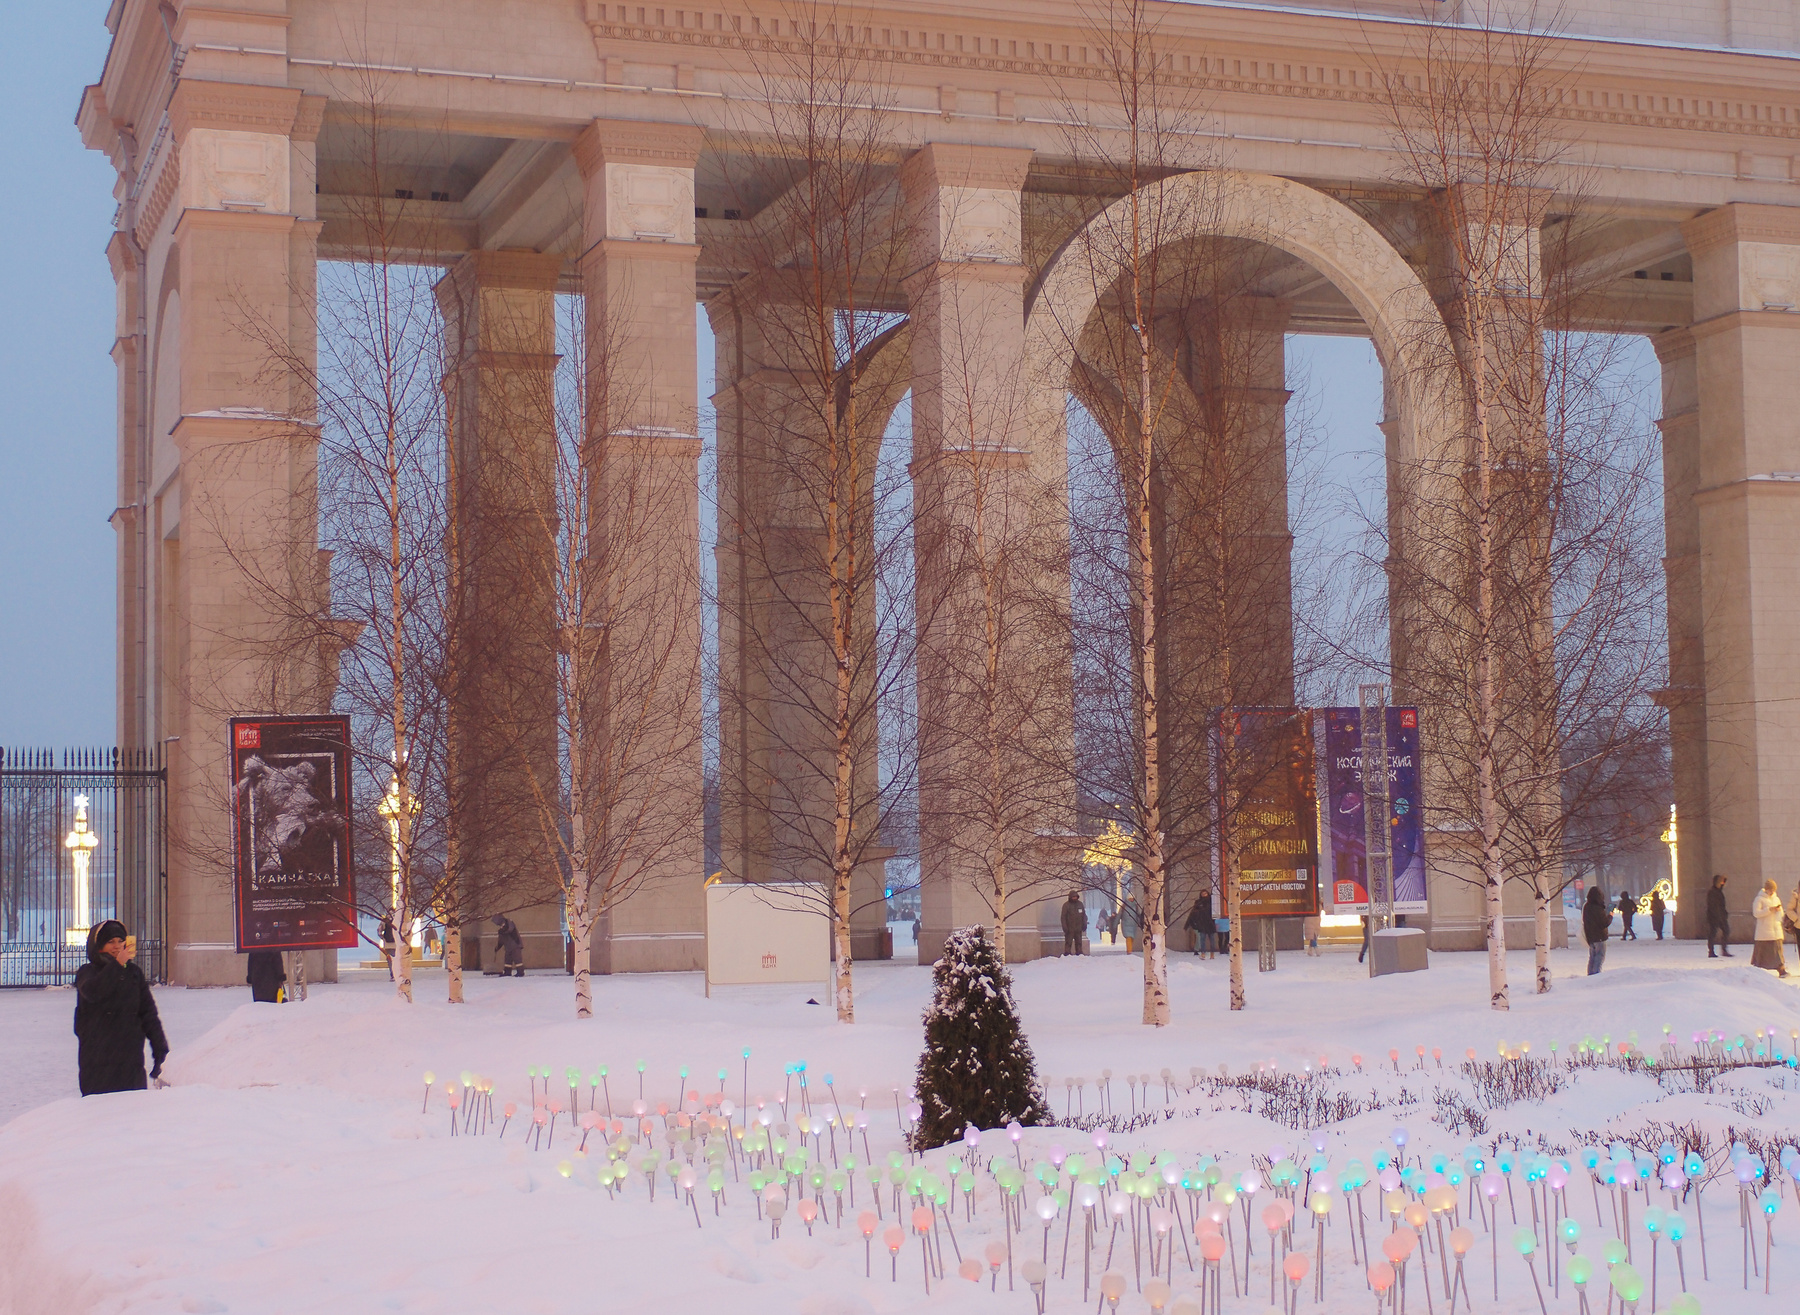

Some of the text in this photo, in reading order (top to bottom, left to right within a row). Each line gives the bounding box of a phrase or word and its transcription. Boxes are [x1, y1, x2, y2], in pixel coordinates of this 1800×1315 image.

[1336, 755, 1412, 769] КОСМЧСКИЙ
[1254, 870, 1284, 880] ПАВИЛЬОН
[1284, 870, 1292, 878] 33
